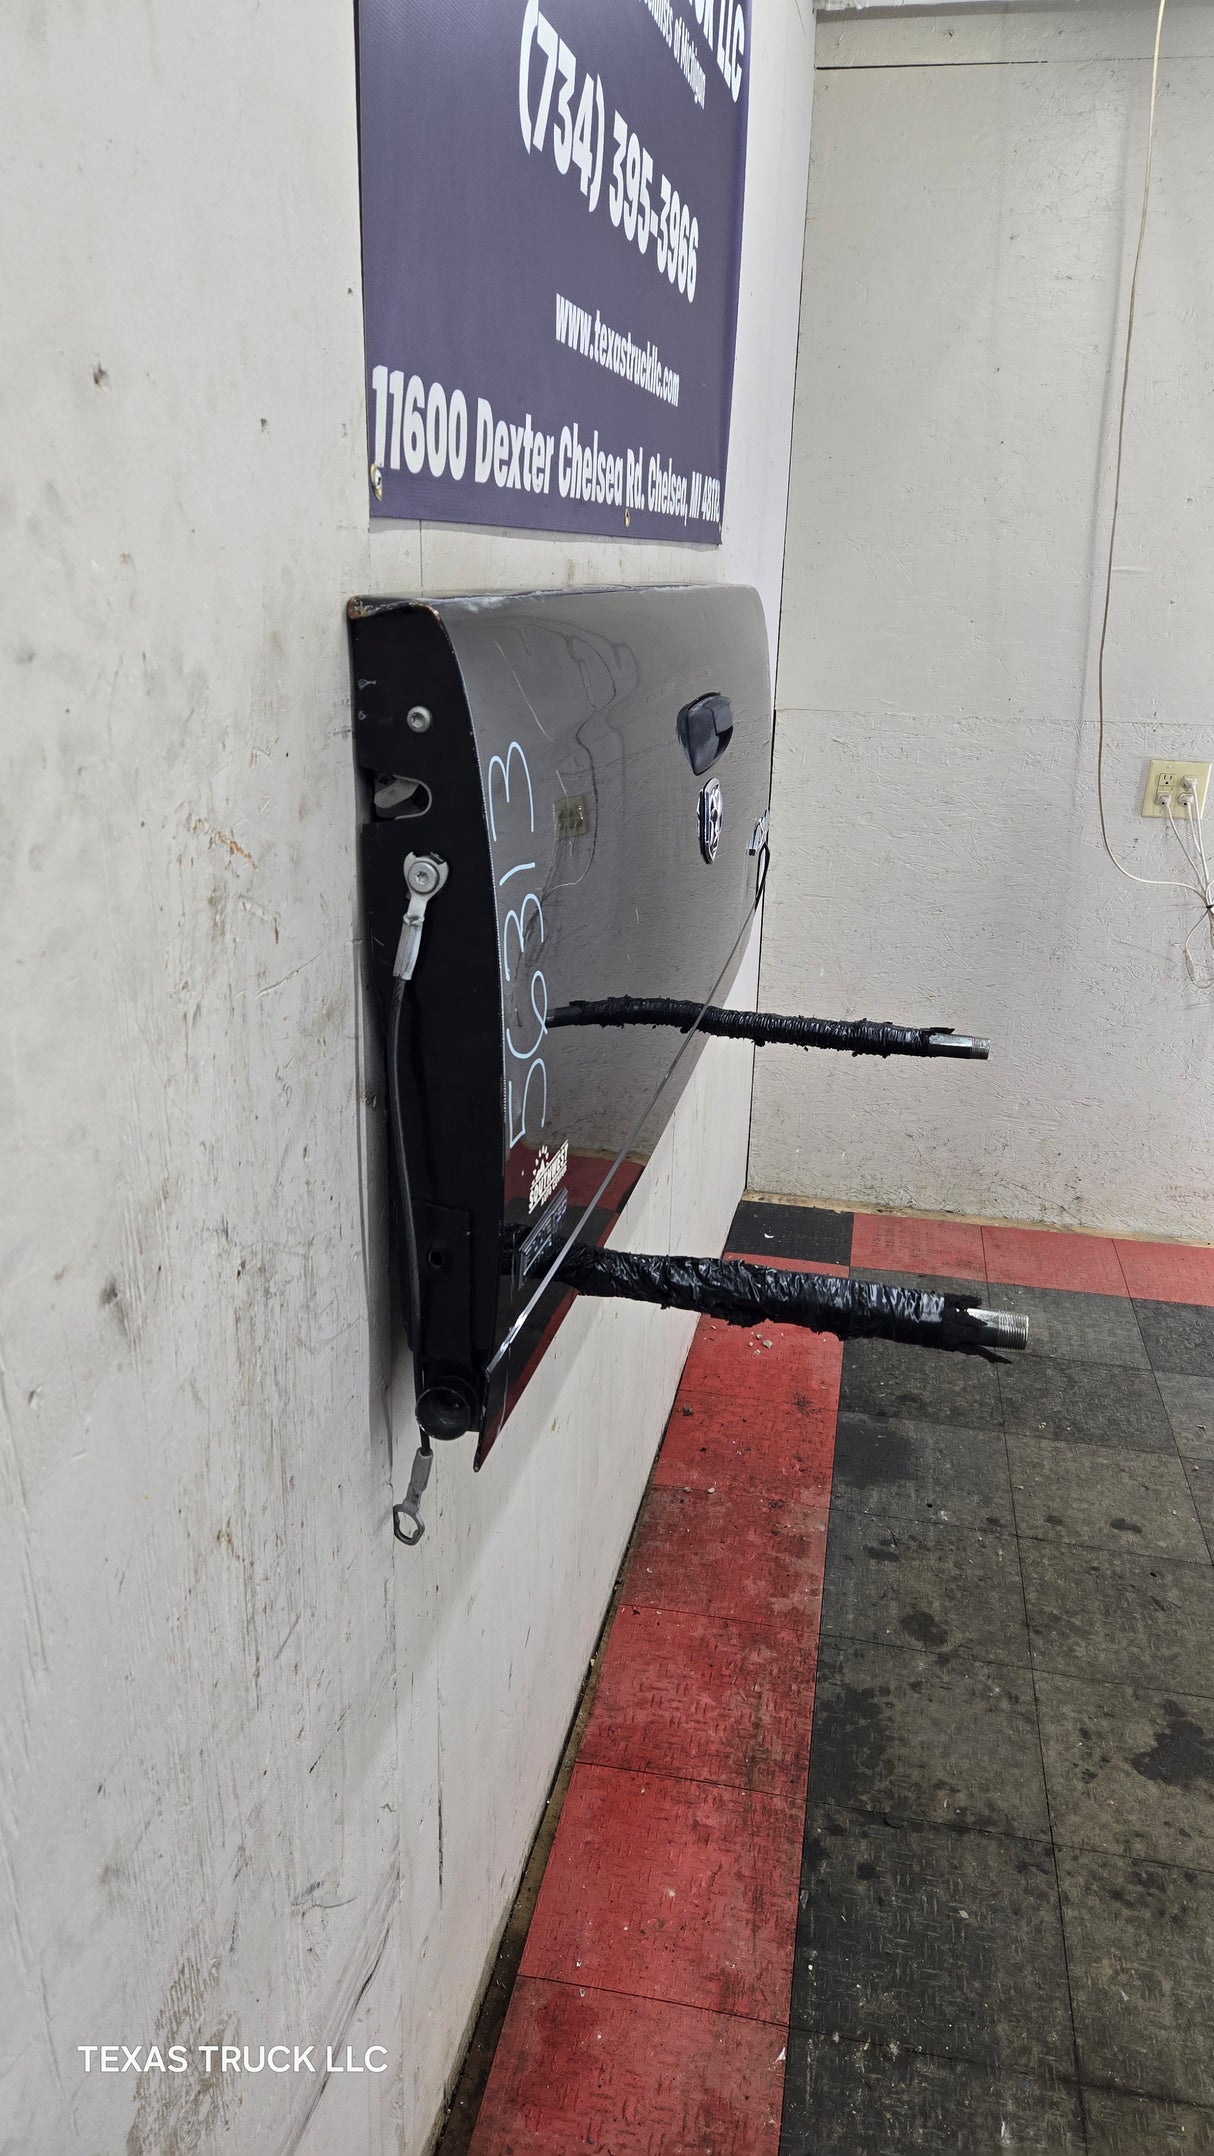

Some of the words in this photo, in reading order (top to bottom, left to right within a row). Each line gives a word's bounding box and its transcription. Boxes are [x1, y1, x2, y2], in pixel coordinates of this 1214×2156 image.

[673, 17, 683, 63] of
[717, 0, 745, 103] LLC
[519, 0, 605, 213] (734)
[610, 111, 698, 303] 395-3966
[556, 293, 680, 407] www.texastruckllc.com
[372, 365, 468, 481] 11600
[475, 398, 554, 494] Dexter
[558, 422, 623, 507] Chelsea
[626, 447, 645, 510] Rd.
[648, 453, 688, 527] Chelsea,
[689, 471, 703, 519] MI
